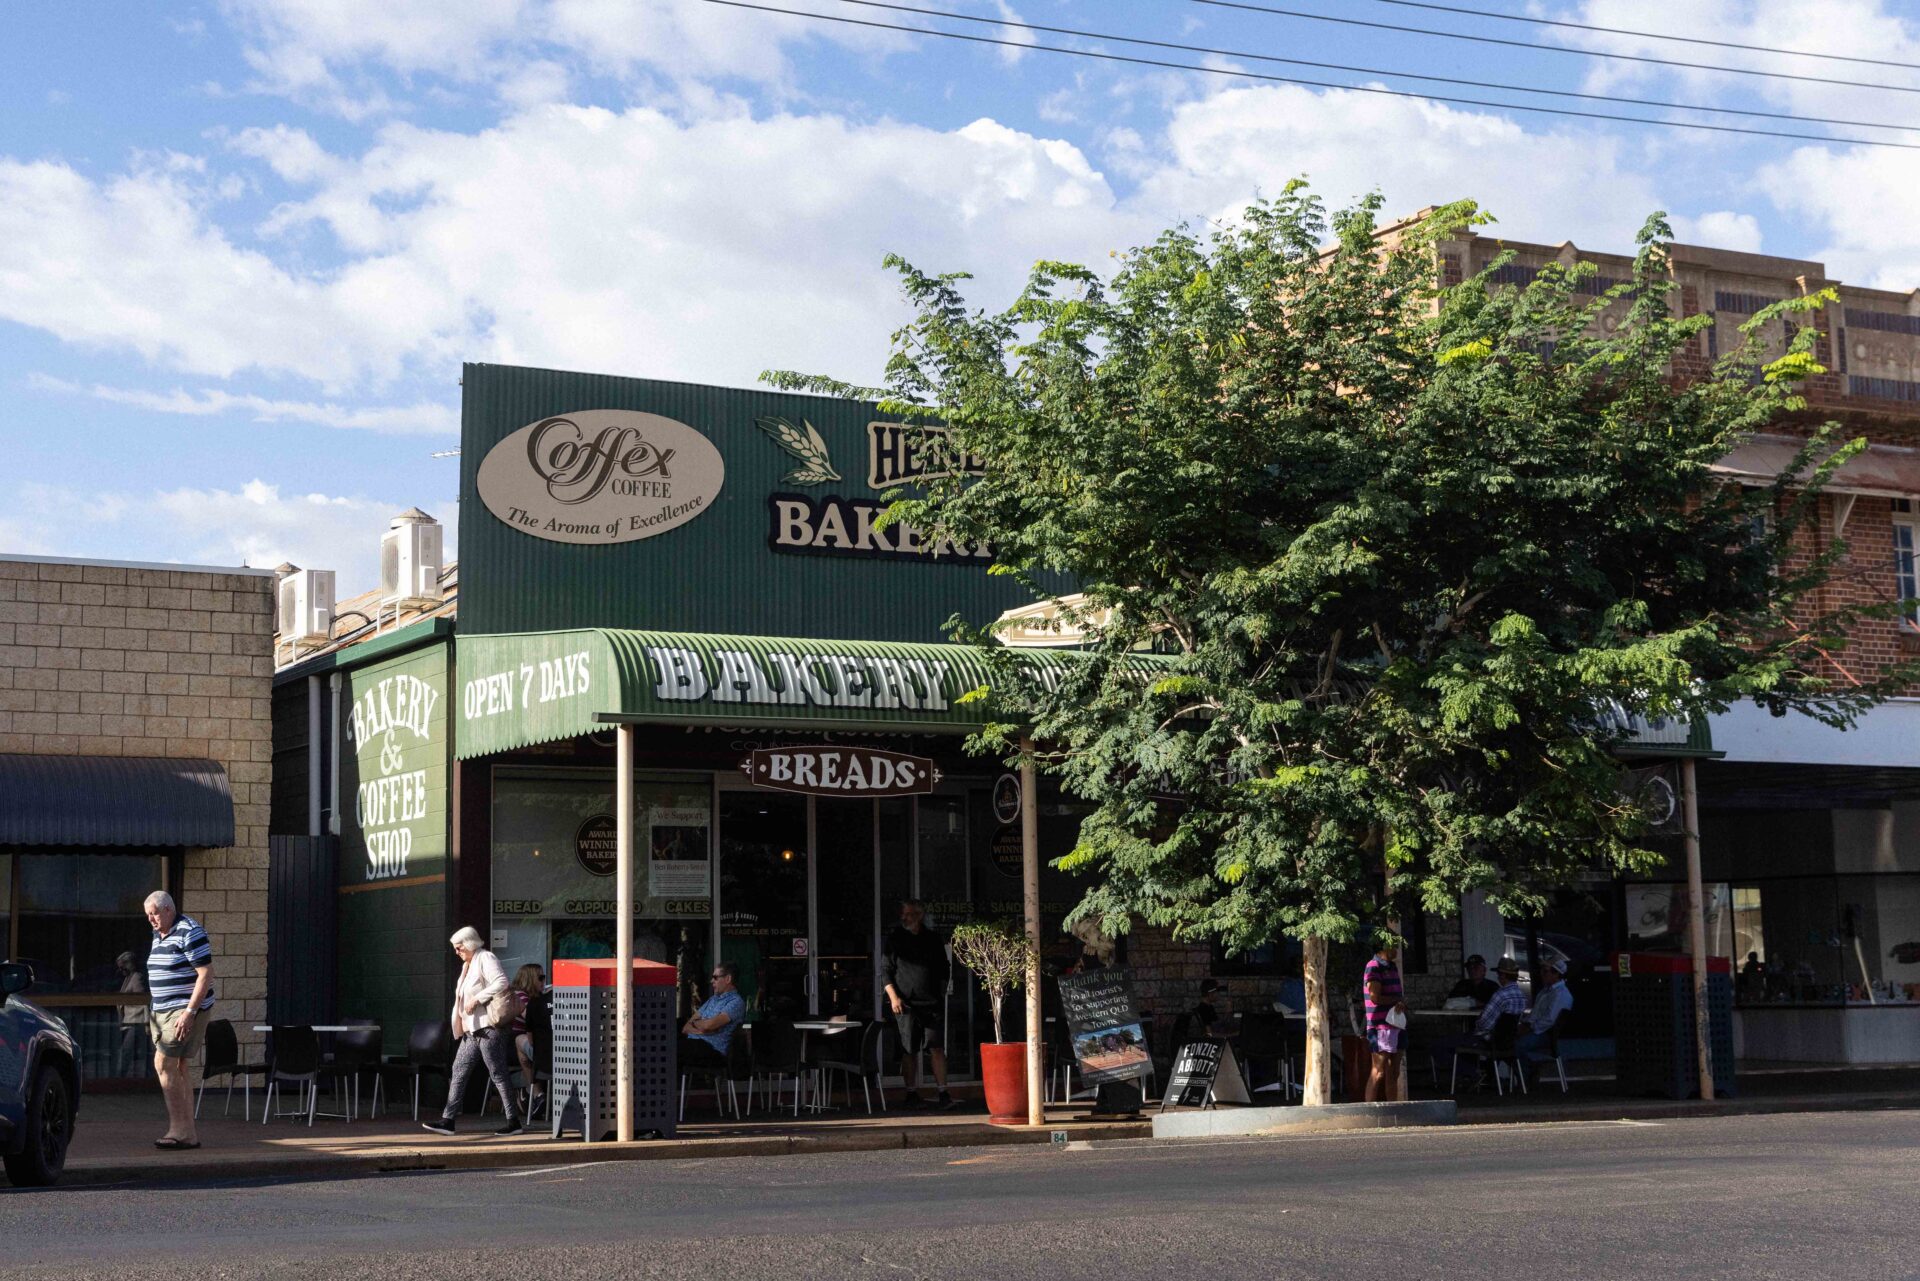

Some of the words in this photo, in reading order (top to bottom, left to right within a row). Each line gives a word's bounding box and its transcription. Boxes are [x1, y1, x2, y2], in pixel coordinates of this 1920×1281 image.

[527, 418, 677, 505] Coffex
[611, 478, 672, 499] COFFEE
[508, 506, 539, 528] The
[543, 517, 601, 535] Aroma
[605, 517, 622, 538] of
[629, 495, 703, 531] Excellence
[464, 670, 513, 720] OPEN
[519, 663, 534, 709] 7
[539, 650, 590, 703] DAYS
[648, 646, 949, 711] BAKERY
[347, 674, 439, 755] BAKERY
[380, 729, 402, 775] &
[769, 751, 916, 789] BREADS
[356, 770, 426, 829] COFFEE
[365, 827, 412, 880] SHOP
[494, 901, 543, 914] BREAD
[665, 901, 711, 914] CAKES
[1086, 995, 1129, 1010] supporting
[1177, 1058, 1214, 1075] ABBOTT
[1183, 1042, 1219, 1059] FONZIE
[1053, 1132, 1066, 1143] 84
